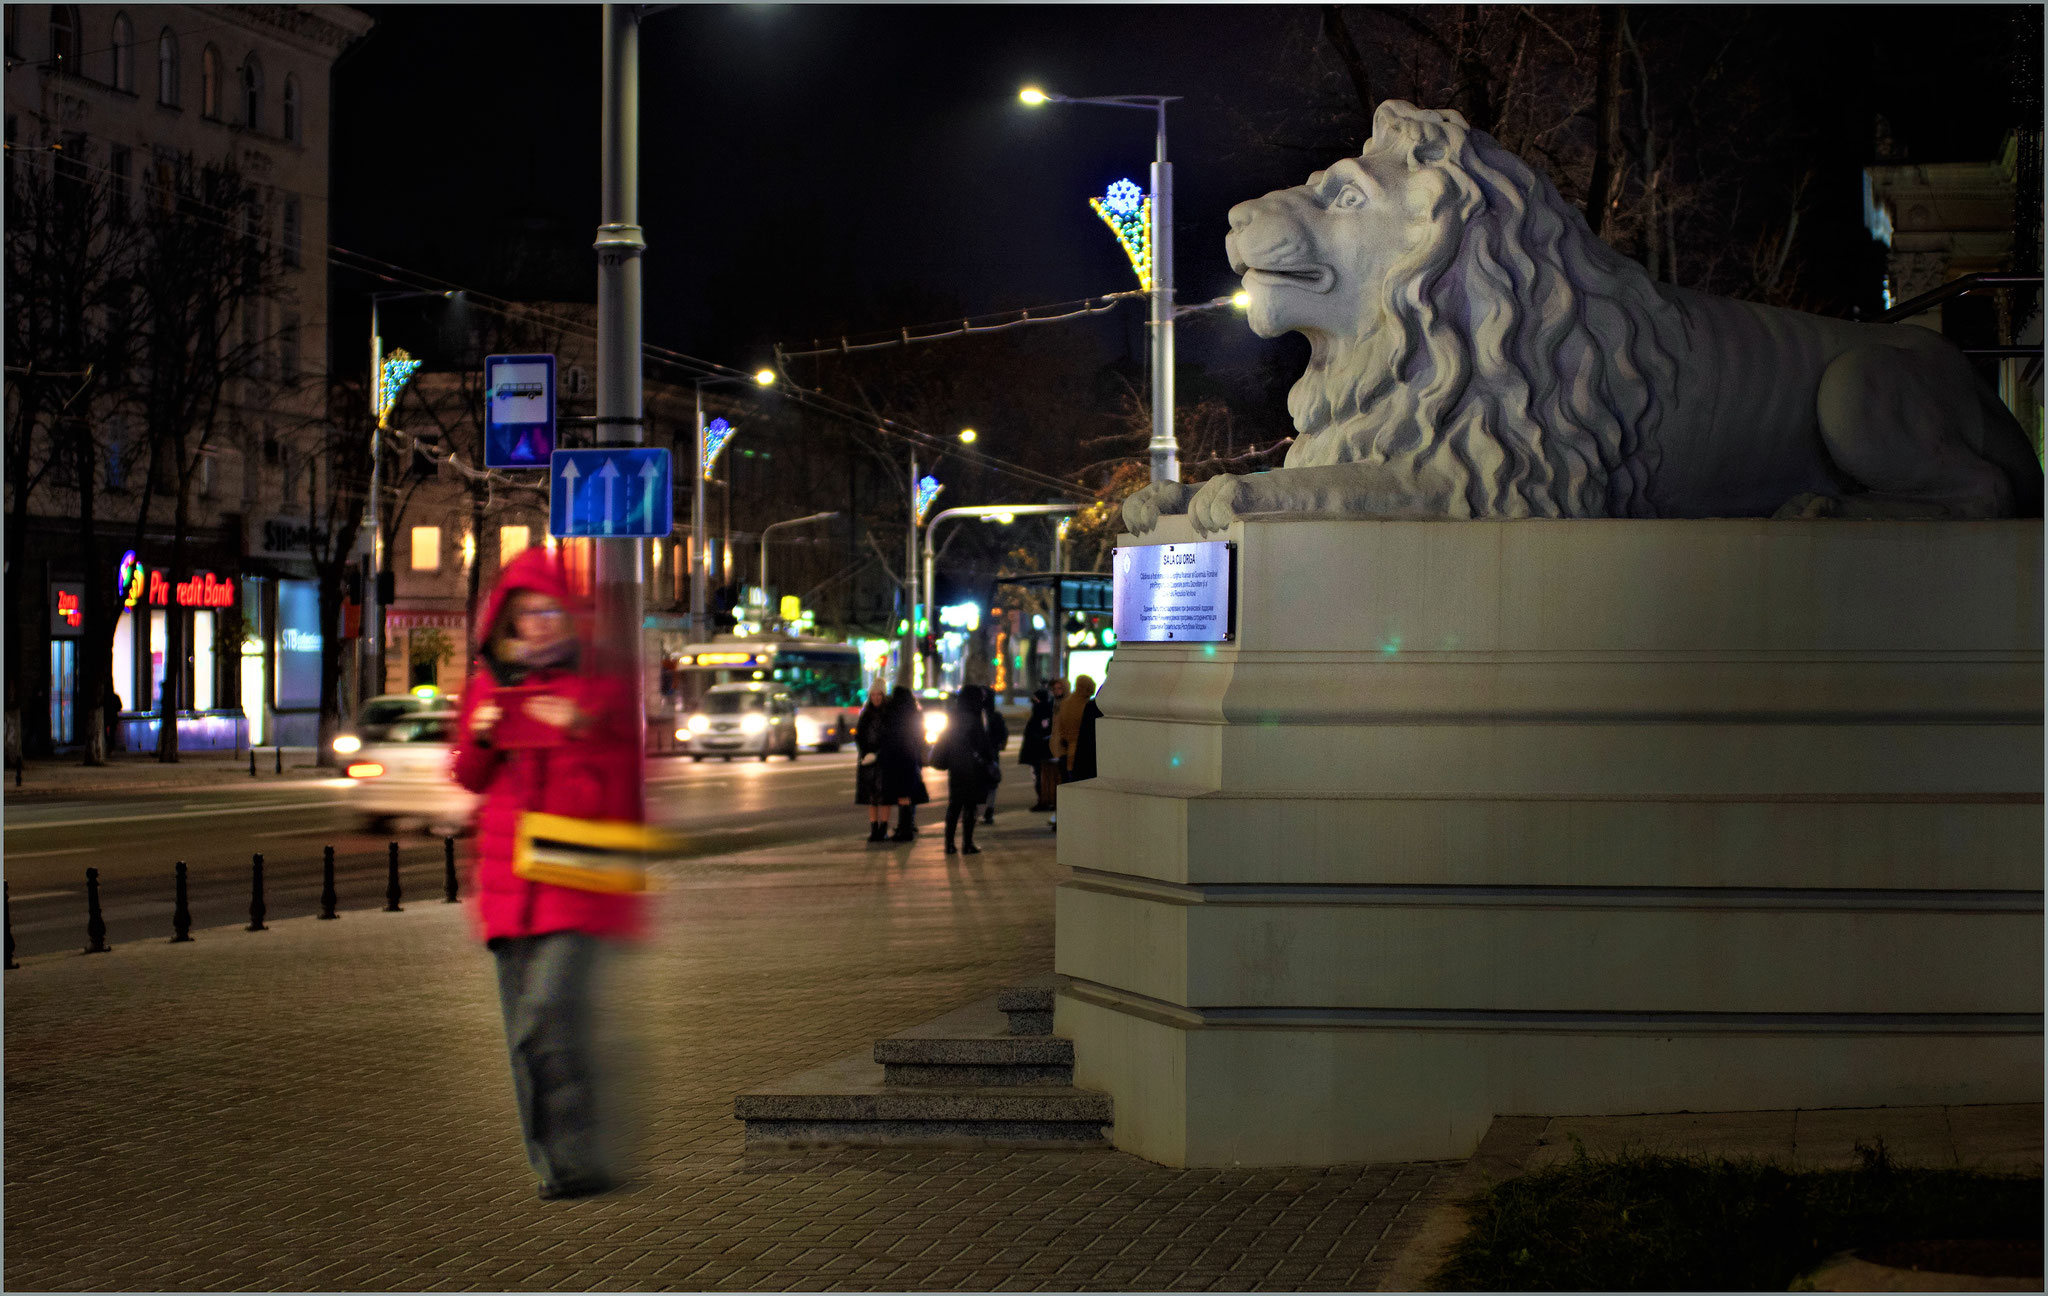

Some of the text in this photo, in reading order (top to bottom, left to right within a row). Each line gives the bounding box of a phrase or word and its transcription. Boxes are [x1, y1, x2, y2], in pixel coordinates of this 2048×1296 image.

[1163, 554, 1175, 565] SALA
[1183, 553, 1196, 564] ORGA
[204, 572, 235, 607] Bank
[58, 590, 79, 609] Zona
